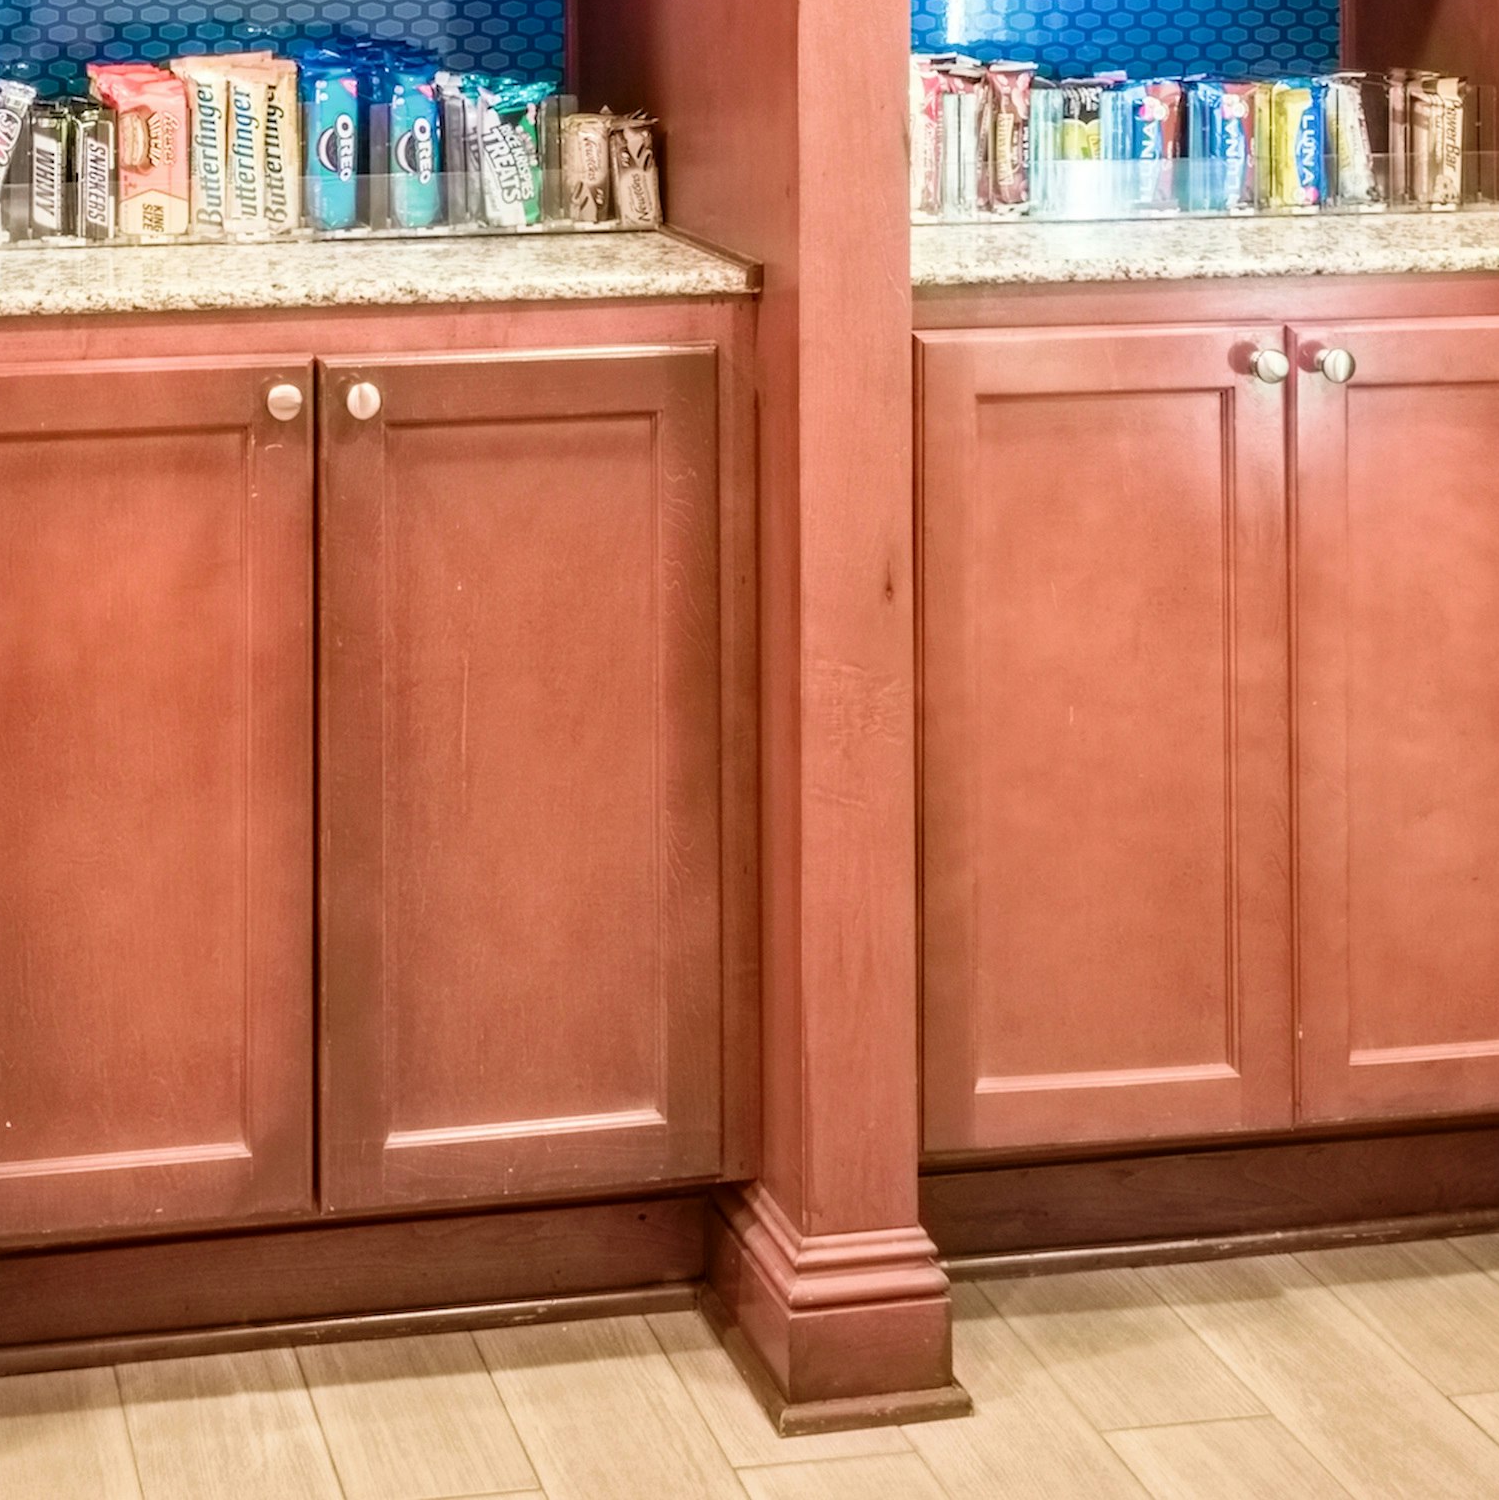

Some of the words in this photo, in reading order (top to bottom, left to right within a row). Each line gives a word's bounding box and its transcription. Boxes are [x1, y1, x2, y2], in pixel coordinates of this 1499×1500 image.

[232, 85, 260, 221] utterfinger
[335, 113, 355, 182] OREO
[413, 117, 433, 185] OREO
[482, 127, 522, 203] TREATS
[1302, 114, 1317, 187] LUNA
[87, 141, 108, 227] SNICKERS
[142, 203, 154, 232] SIZE
[153, 204, 165, 233] KING
